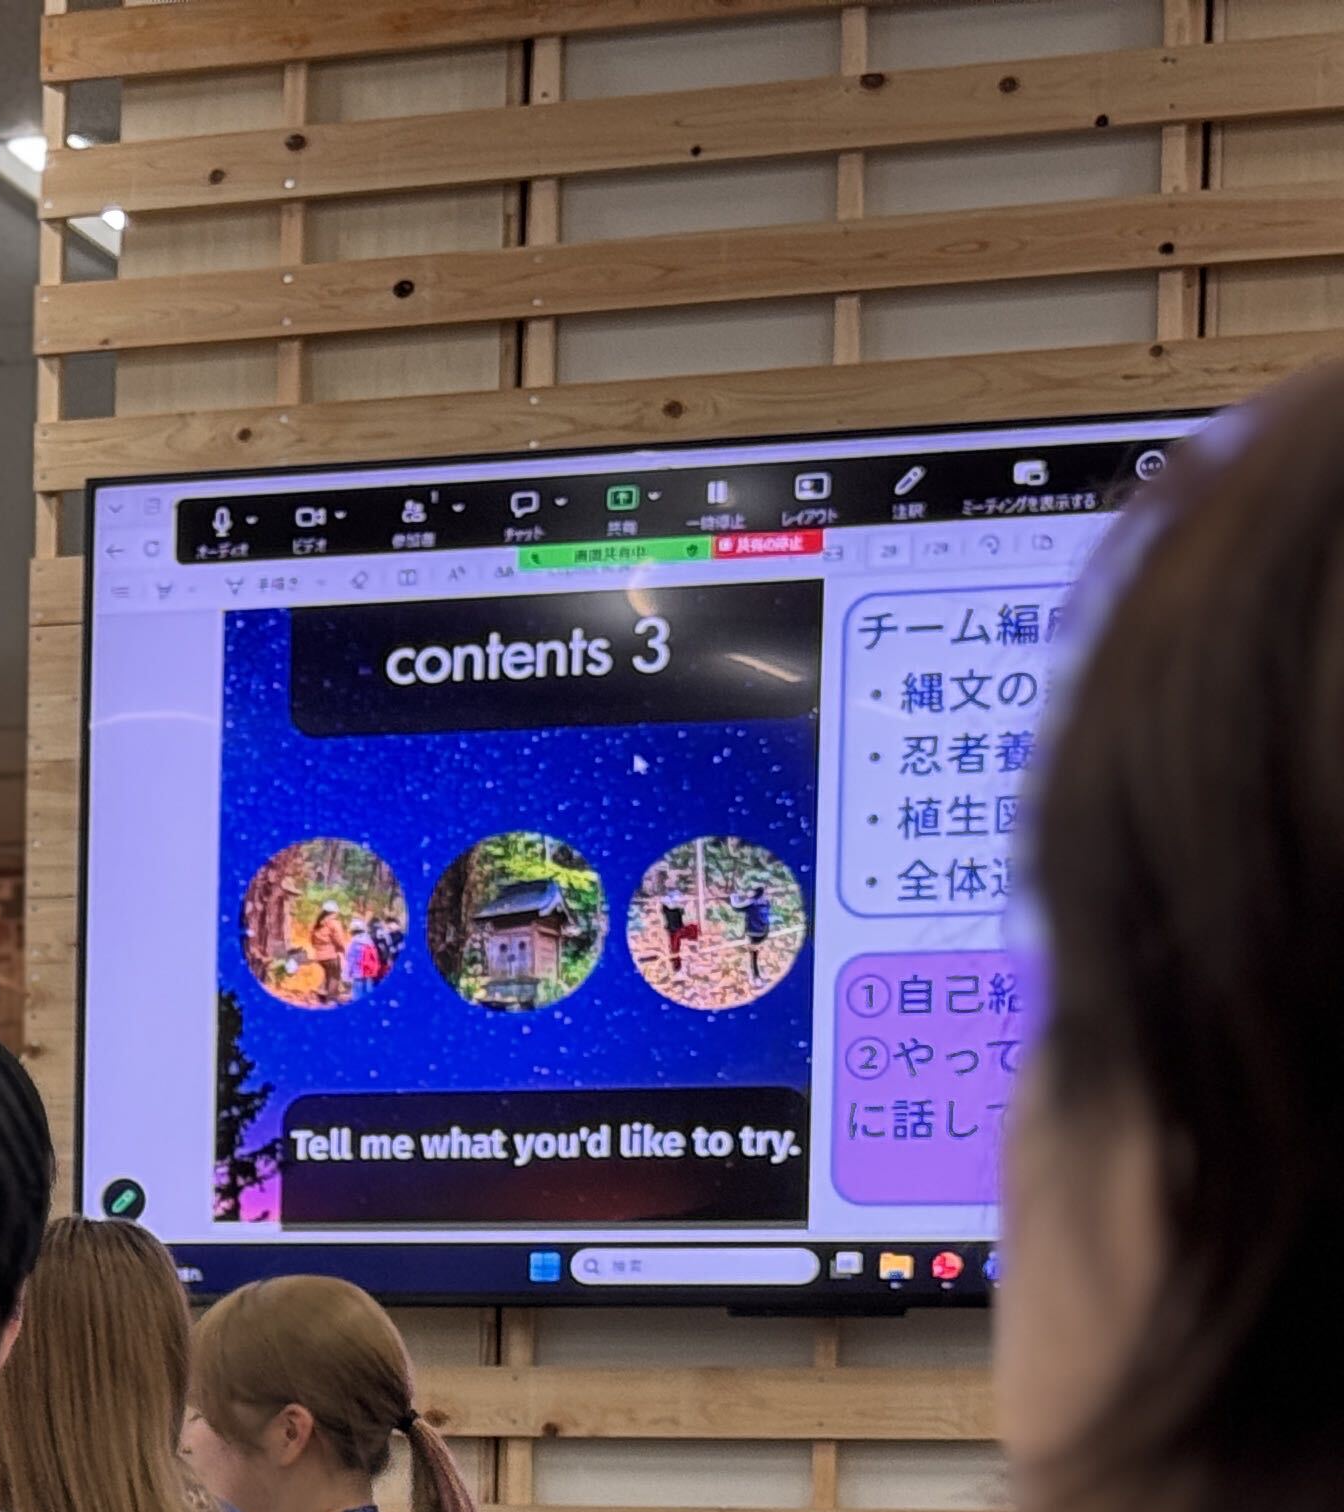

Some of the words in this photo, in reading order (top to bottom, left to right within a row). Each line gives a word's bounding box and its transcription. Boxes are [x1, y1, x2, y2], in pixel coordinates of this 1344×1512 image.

[385, 627, 613, 686] contents
[631, 615, 672, 676] 3
[847, 1100, 1010, 1141] に話し
[289, 1127, 353, 1161] Tell
[359, 1135, 413, 1160] me
[420, 1126, 509, 1161] what
[513, 1124, 612, 1167] you'd
[619, 1122, 686, 1159] like
[691, 1126, 735, 1158] to
[738, 1125, 802, 1164] try.
